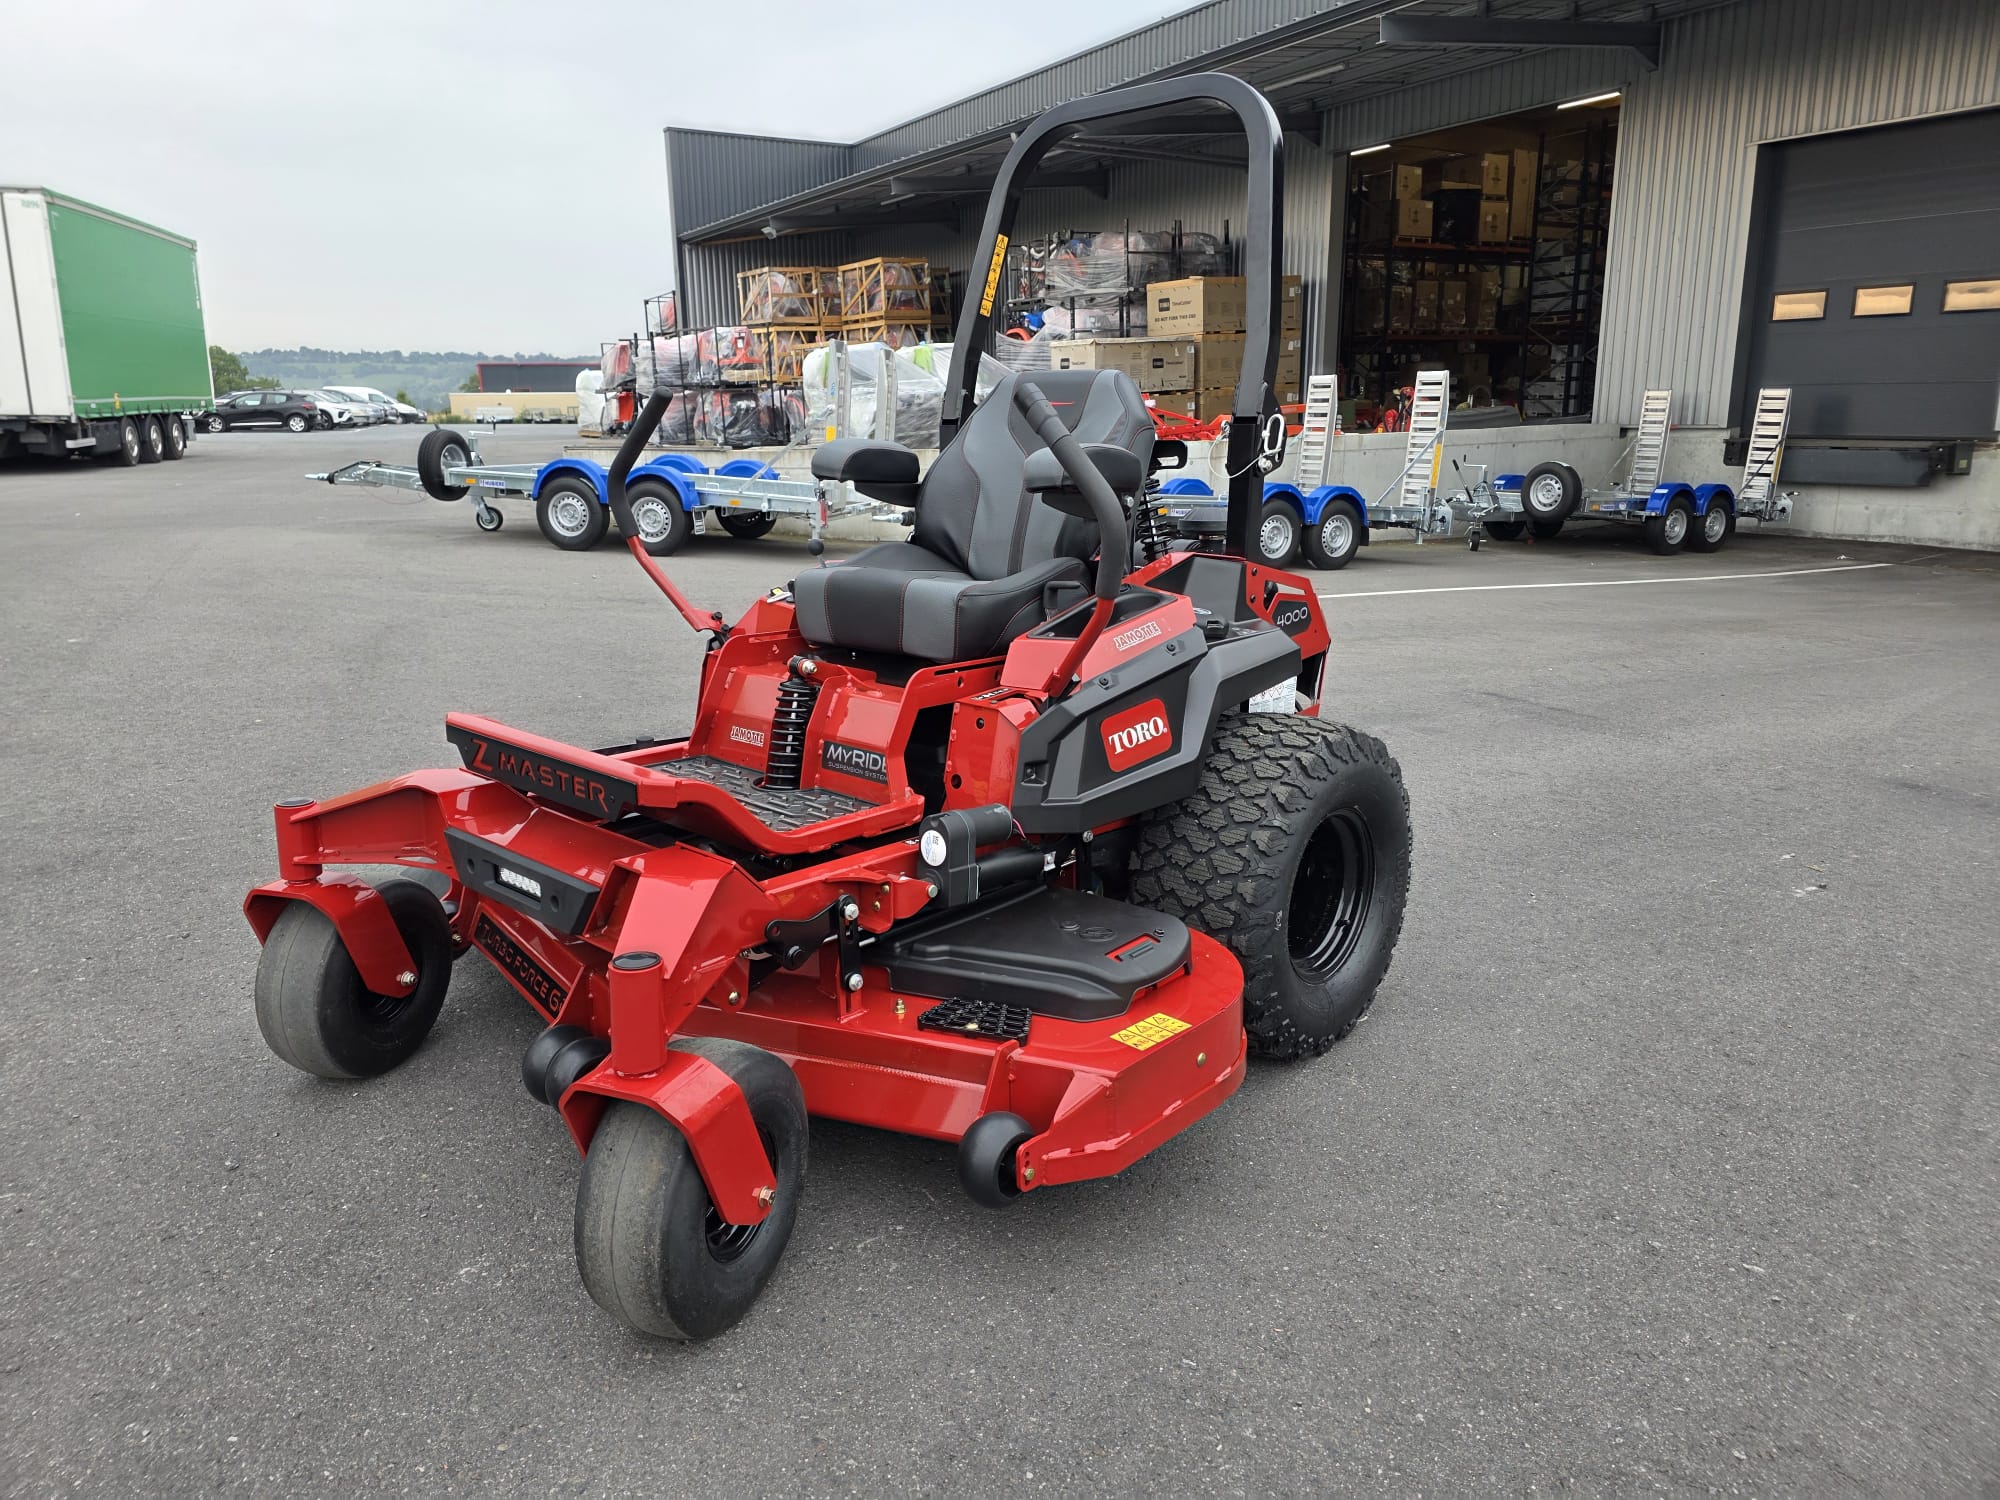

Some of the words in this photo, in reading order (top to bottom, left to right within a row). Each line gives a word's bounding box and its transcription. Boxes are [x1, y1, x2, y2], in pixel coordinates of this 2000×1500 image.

[1276, 606, 1308, 627] 4000
[1114, 621, 1161, 650] JAMOTTE
[730, 726, 764, 746] JAMOTTE
[471, 739, 493, 772] Z
[498, 751, 609, 813] MASTER
[482, 924, 514, 963] TURBO
[513, 956, 549, 998] FORCE
